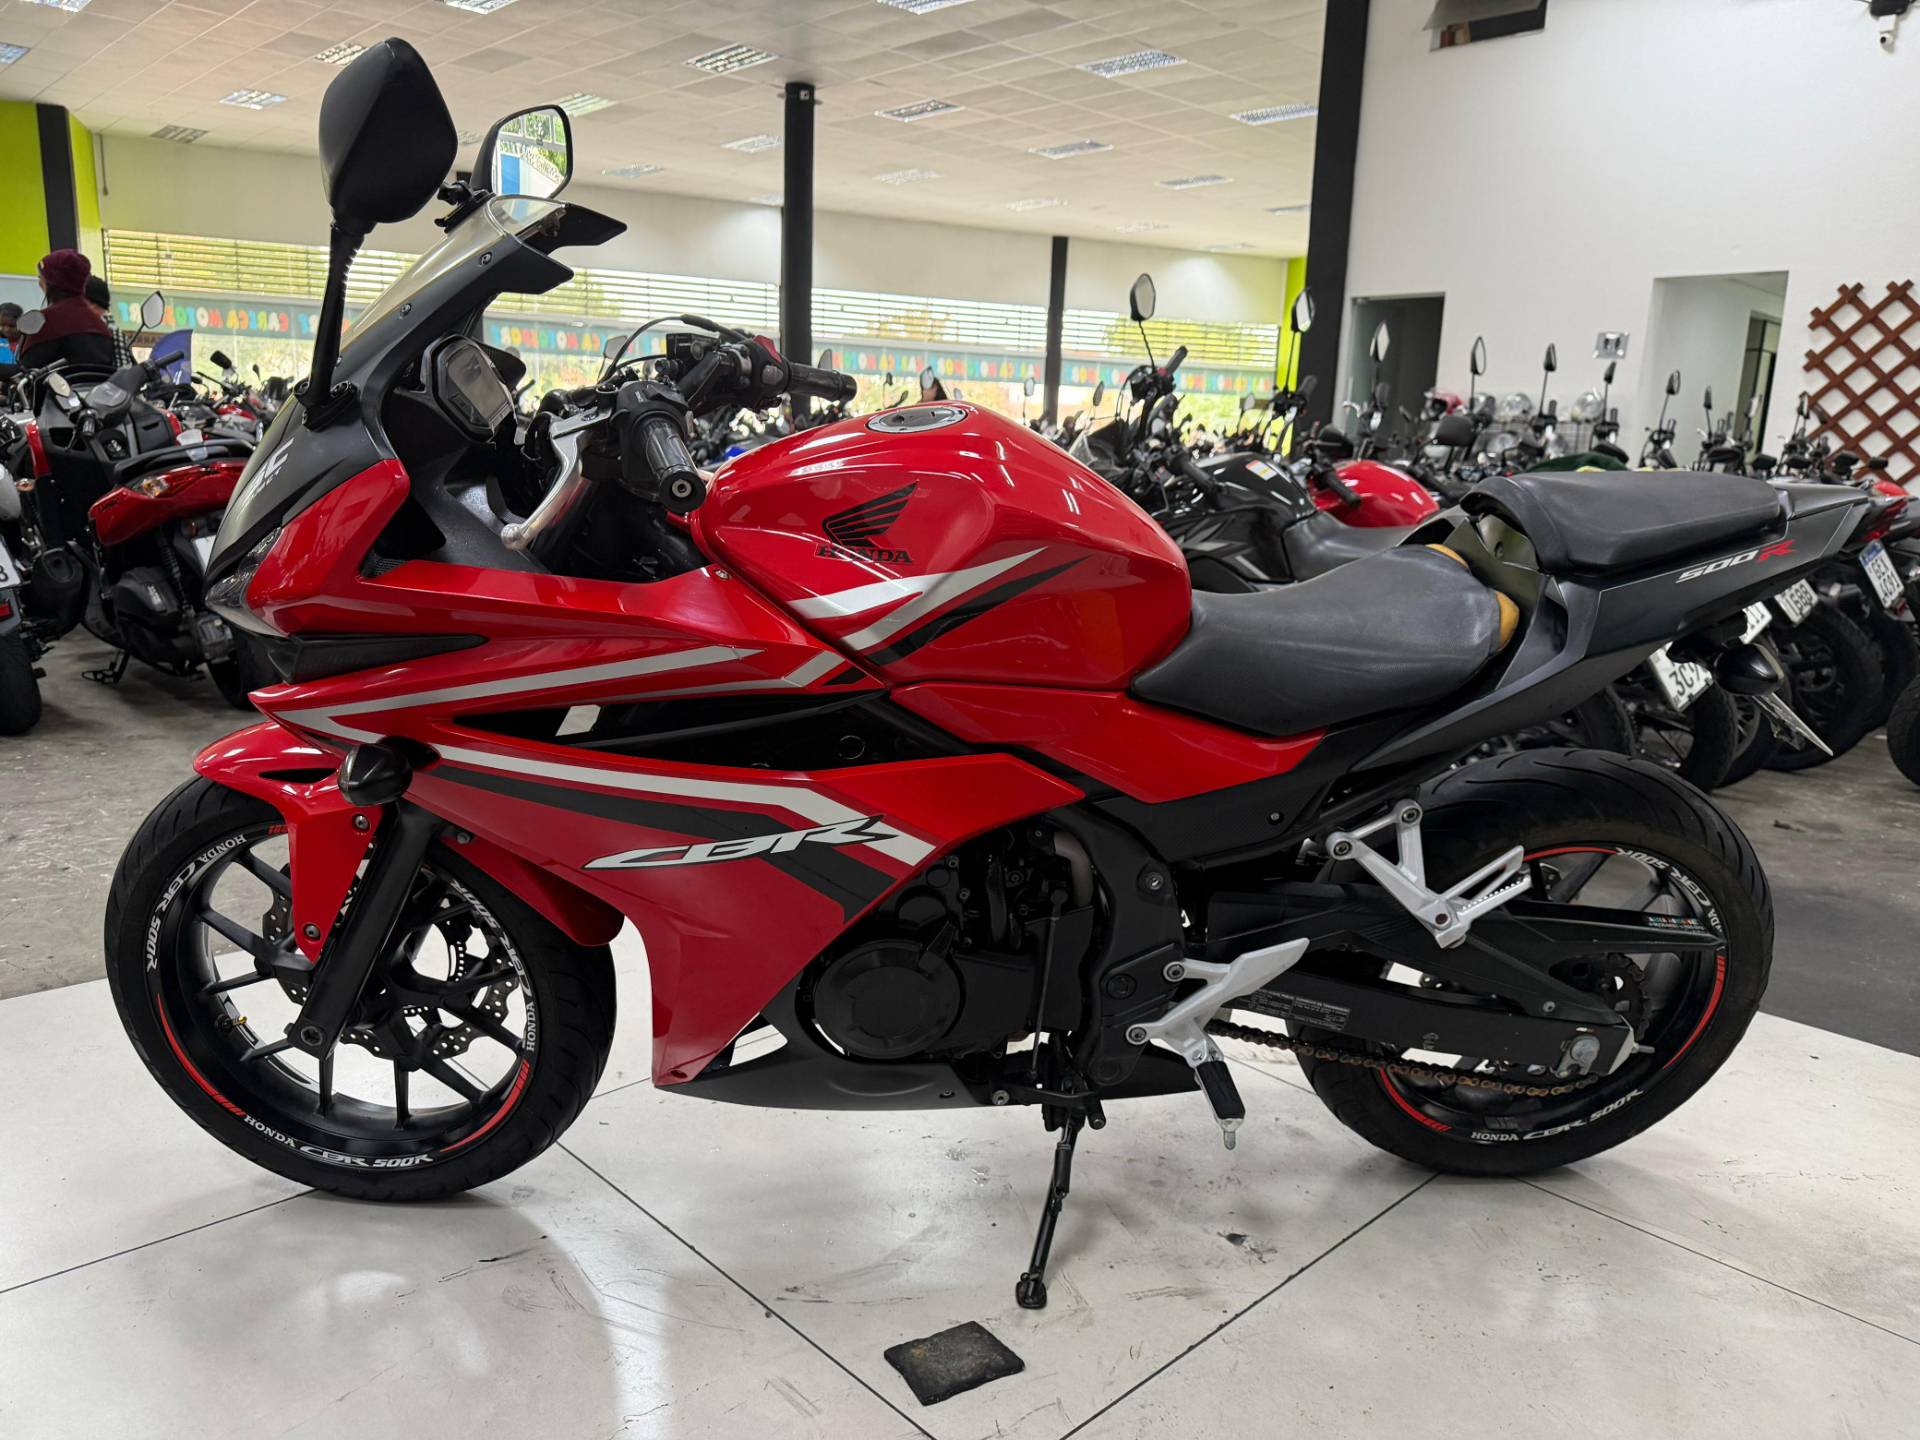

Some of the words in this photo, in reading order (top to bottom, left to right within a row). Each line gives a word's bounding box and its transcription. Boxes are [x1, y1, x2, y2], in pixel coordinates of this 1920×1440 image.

[818, 545, 912, 563] HONDA
[1675, 540, 1793, 583] 500R
[197, 834, 247, 863] HONDA
[581, 815, 899, 869] CBR
[1616, 847, 1670, 869] 500R
[155, 862, 196, 912] CBR
[450, 879, 501, 928] 500R
[1670, 867, 1712, 906] CBR
[146, 915, 161, 973] 500R
[500, 932, 532, 997] CBR
[526, 1001, 537, 1052] HONDA
[1471, 1131, 1519, 1141] HONDA
[1523, 1119, 1587, 1140] CBR
[1589, 1089, 1644, 1121] 500R
[244, 1114, 296, 1148] HONDA
[300, 1145, 370, 1167] CBR
[372, 1153, 434, 1168] 500R
